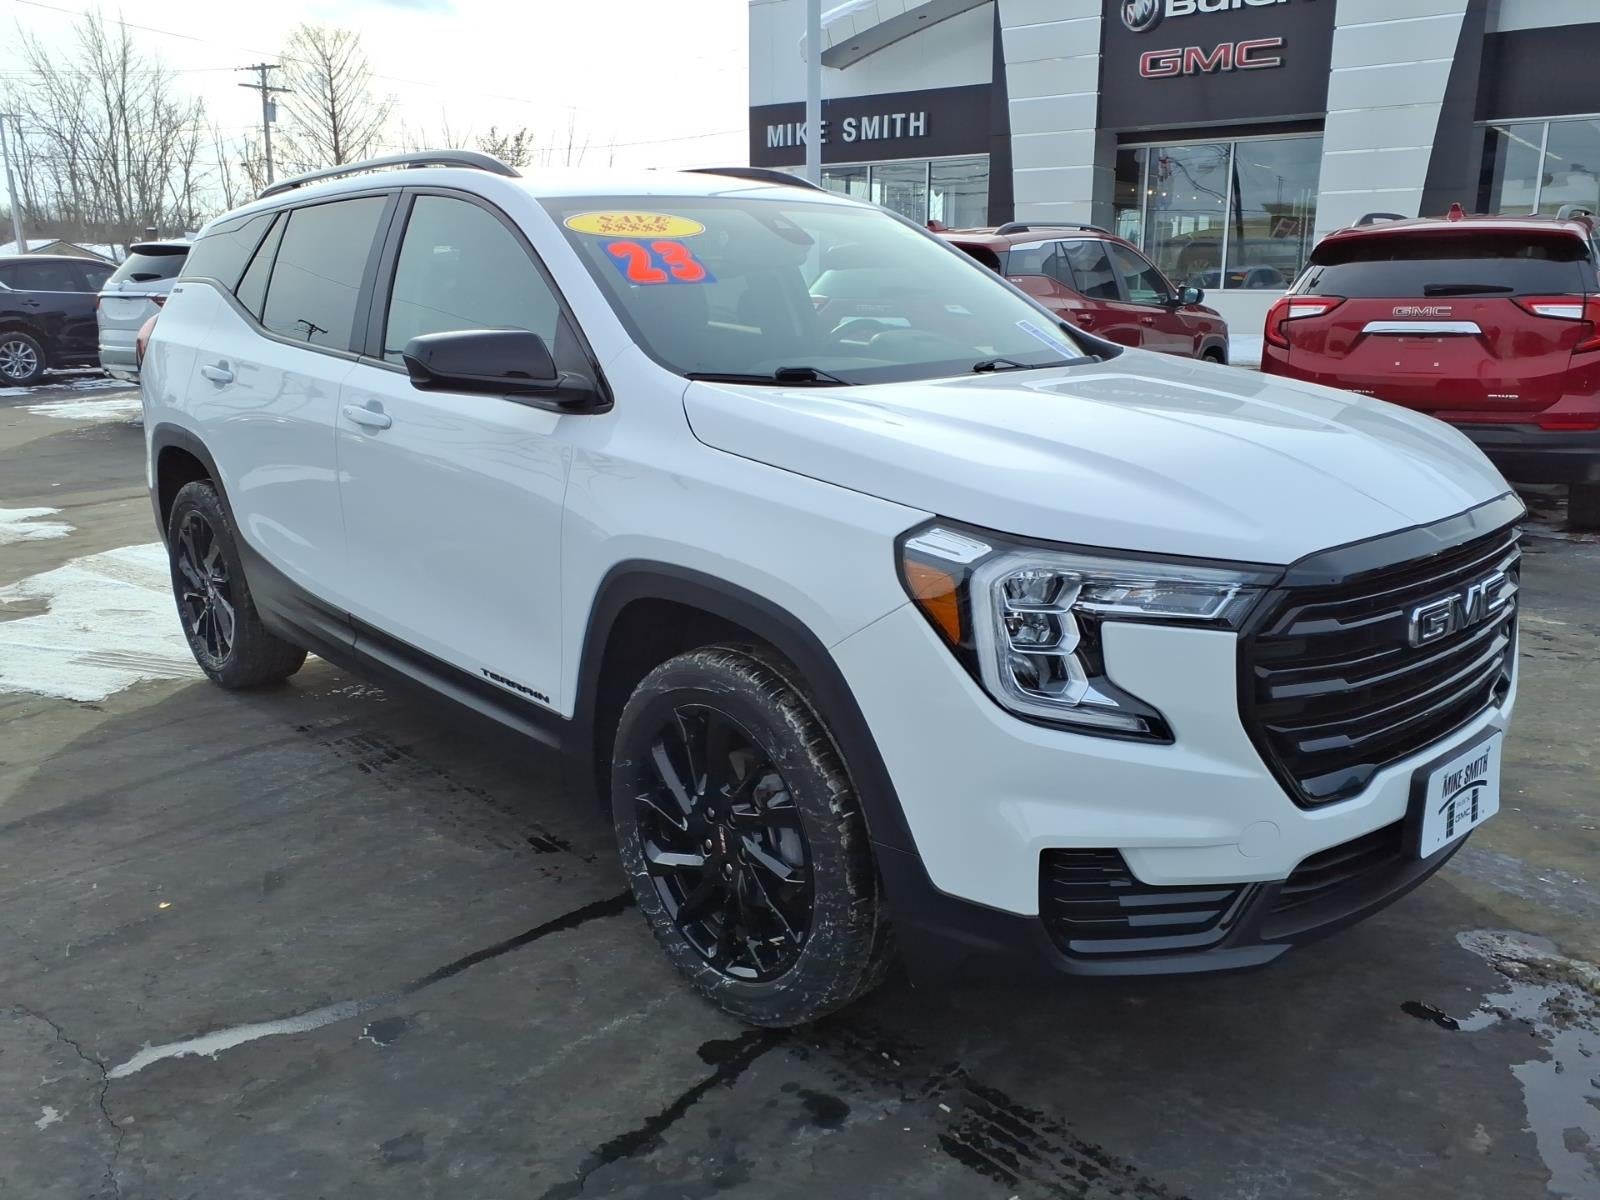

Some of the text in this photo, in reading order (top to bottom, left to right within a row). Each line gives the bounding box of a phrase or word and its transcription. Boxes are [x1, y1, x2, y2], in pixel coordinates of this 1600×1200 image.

[1165, 0, 1287, 17] Bui
[1139, 37, 1283, 78] GMC
[842, 111, 926, 143] SMITH
[607, 240, 706, 284] 23
[1392, 306, 1452, 317] GMC
[1408, 571, 1506, 648] GMC
[480, 667, 550, 704] TERRAIN
[1442, 753, 1489, 799] MIKE SMITH
